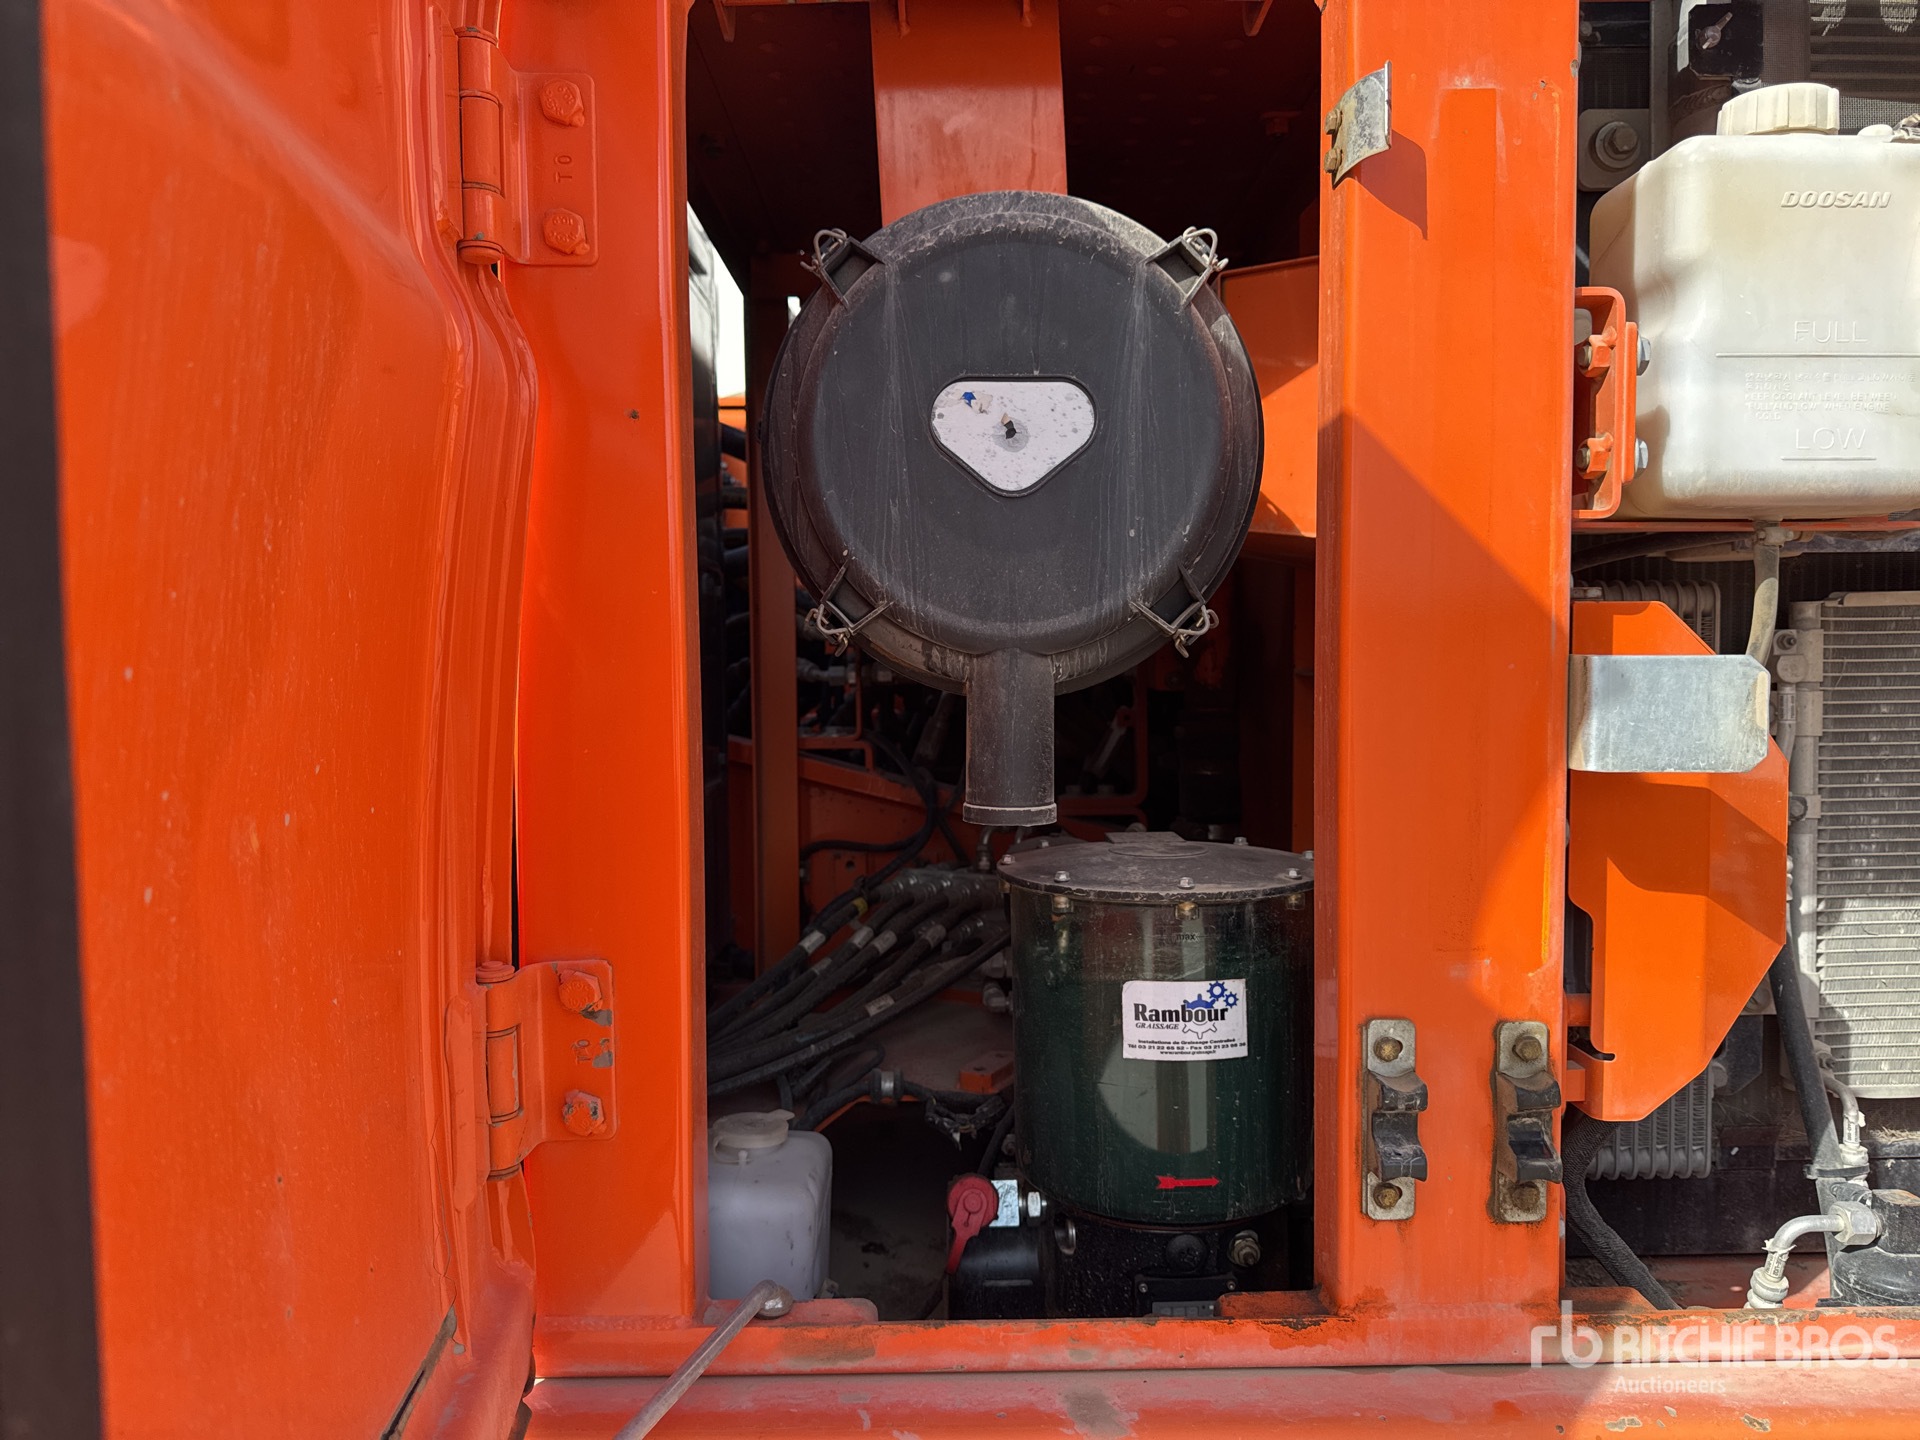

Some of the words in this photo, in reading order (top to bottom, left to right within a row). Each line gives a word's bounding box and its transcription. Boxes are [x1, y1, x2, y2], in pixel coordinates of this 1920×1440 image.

[1780, 190, 1892, 209] DOOSAN
[1793, 320, 1869, 344] FULL
[1772, 391, 1819, 402] COOLANT
[1820, 391, 1849, 402] LEVEL
[1855, 401, 1890, 411] ENGINE
[1795, 427, 1866, 451] LOW
[1177, 933, 1196, 941] max
[1133, 1002, 1229, 1023] Rambour
[1135, 1022, 1180, 1030] GRAISSAGE
